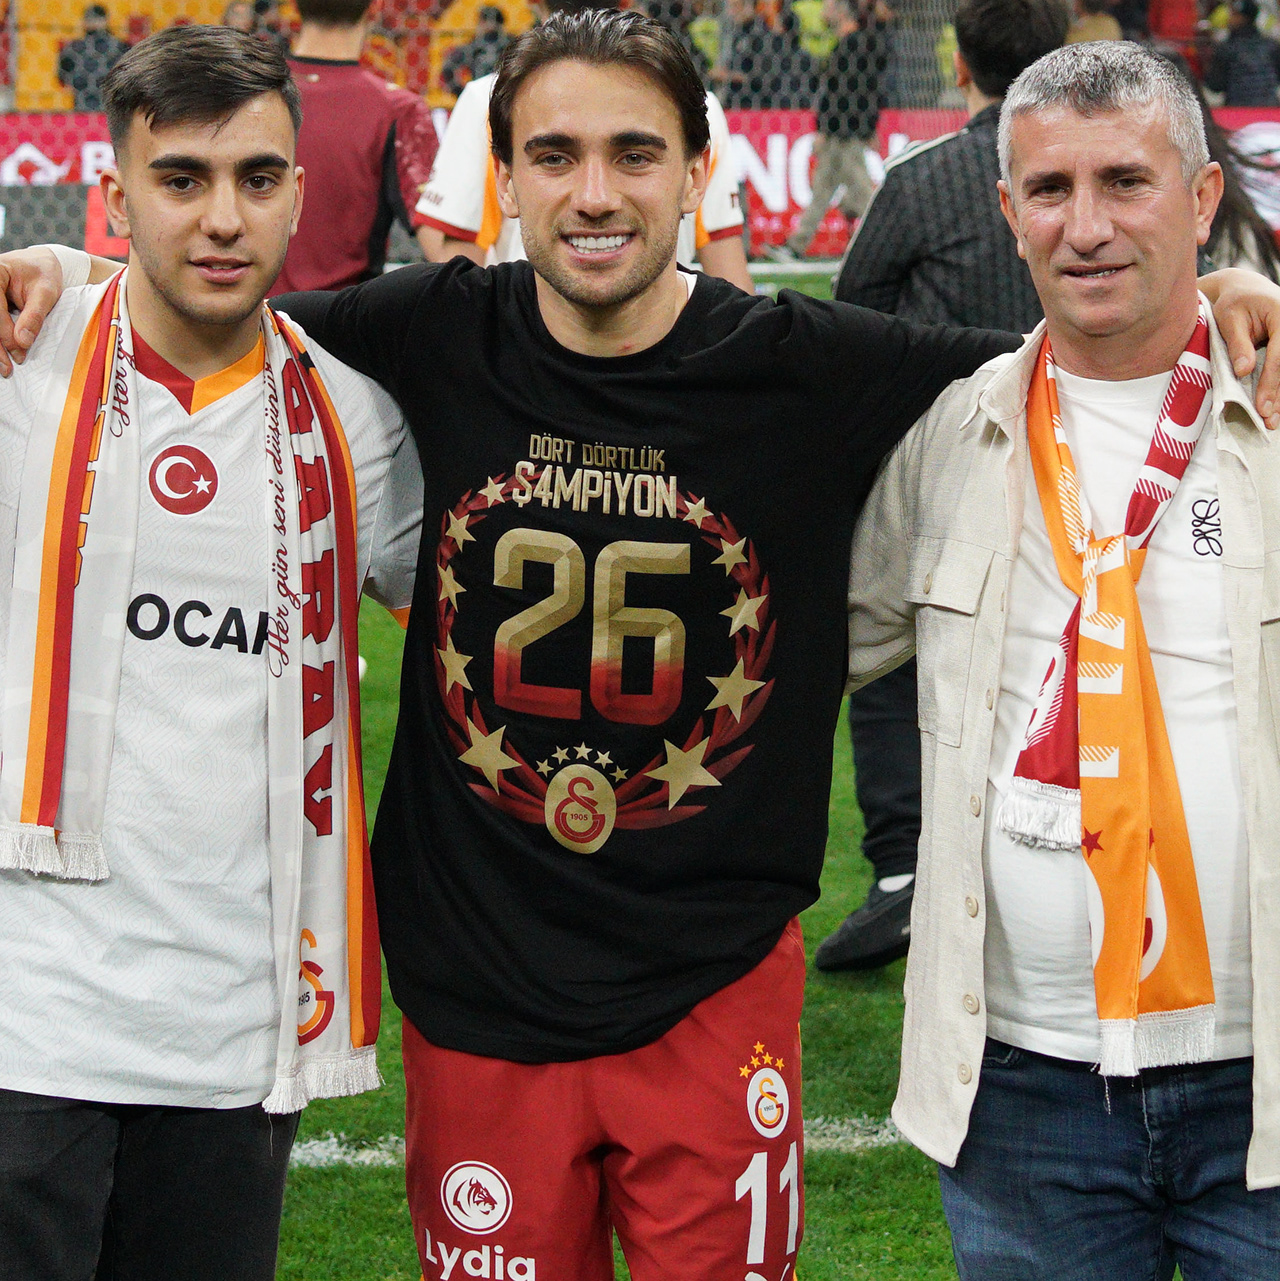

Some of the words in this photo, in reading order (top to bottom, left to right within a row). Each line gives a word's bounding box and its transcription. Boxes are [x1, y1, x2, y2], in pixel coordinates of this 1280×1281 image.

[528, 432, 575, 464] DÖRT
[582, 441, 665, 472] DÖRTLÜK
[269, 479, 287, 537] seni
[271, 542, 302, 610] gün
[267, 604, 289, 678] Her
[493, 527, 691, 726] 26
[570, 813, 588, 821] 1905
[735, 1140, 799, 1264] 11
[425, 1228, 536, 1281] Lydia
